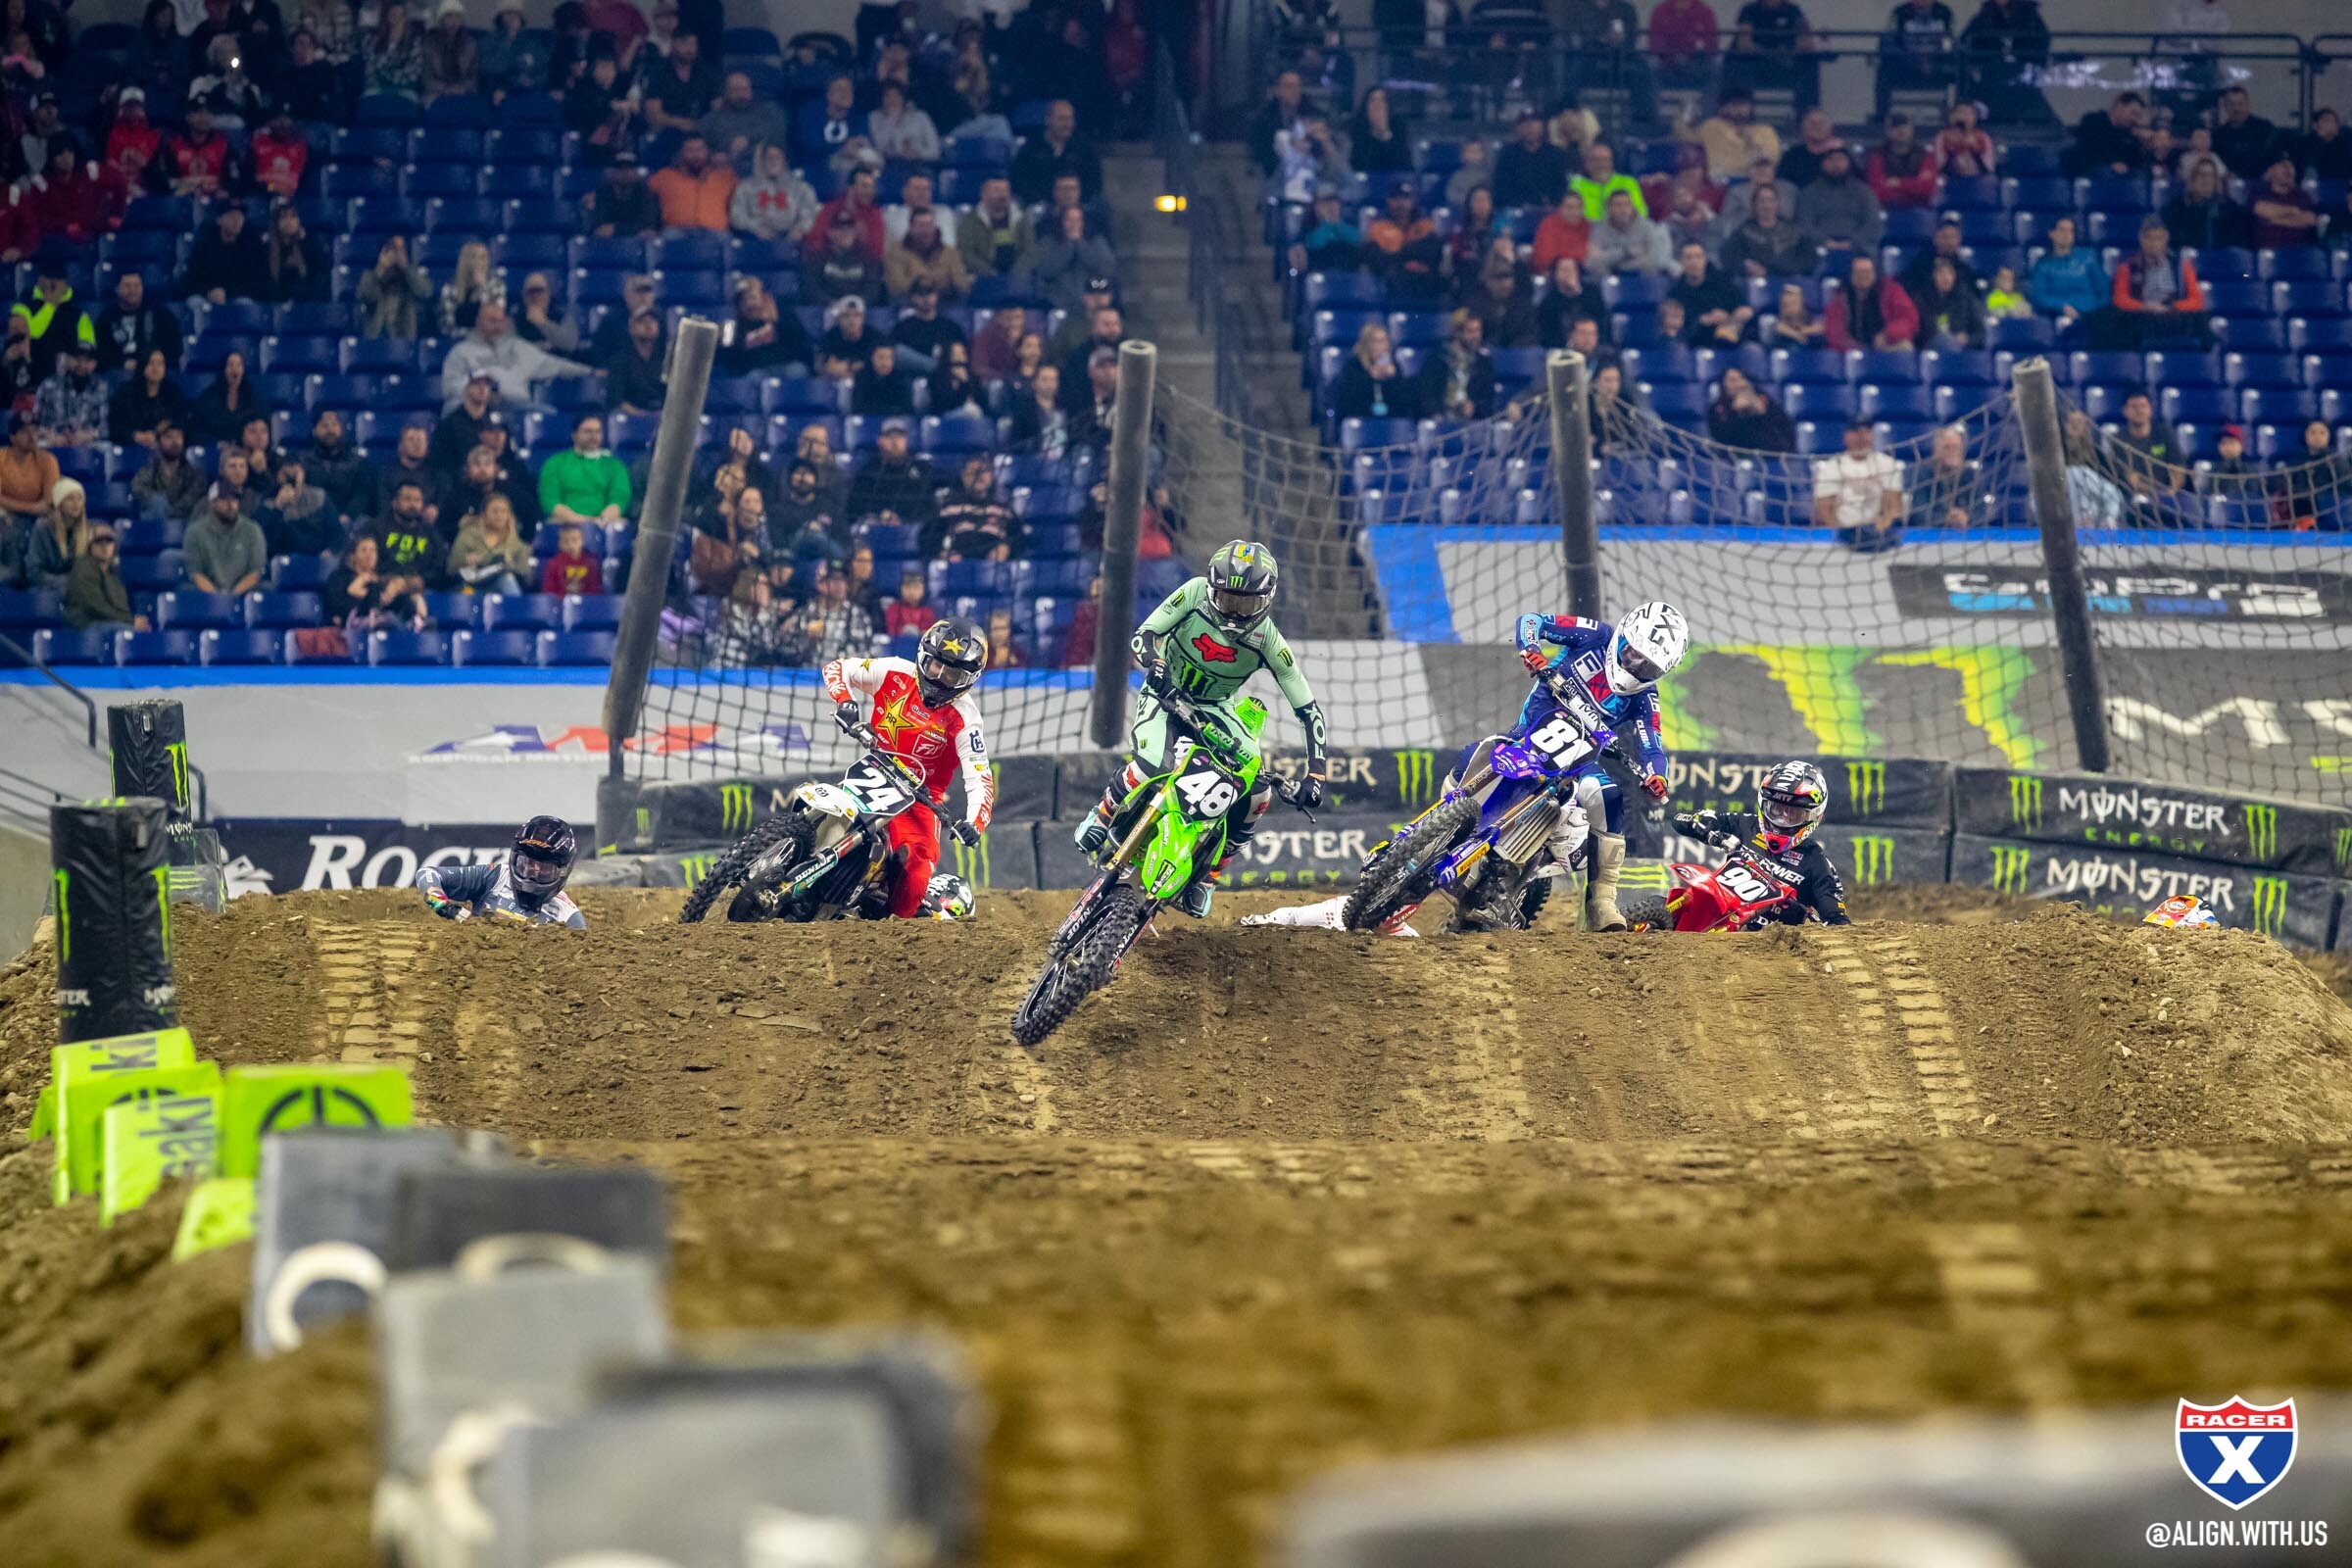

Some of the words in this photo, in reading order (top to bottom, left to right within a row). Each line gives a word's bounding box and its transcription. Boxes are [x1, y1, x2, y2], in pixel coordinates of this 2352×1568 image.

[1304, 703, 1325, 760] FOX
[1530, 718, 1593, 769] 81
[837, 767, 905, 812] 24
[1175, 771, 1238, 817] 48
[2059, 787, 2230, 835] MONSTER
[2084, 826, 2205, 853] ENERGY
[1716, 866, 1768, 903] 90
[2047, 857, 2236, 912] MONSTER
